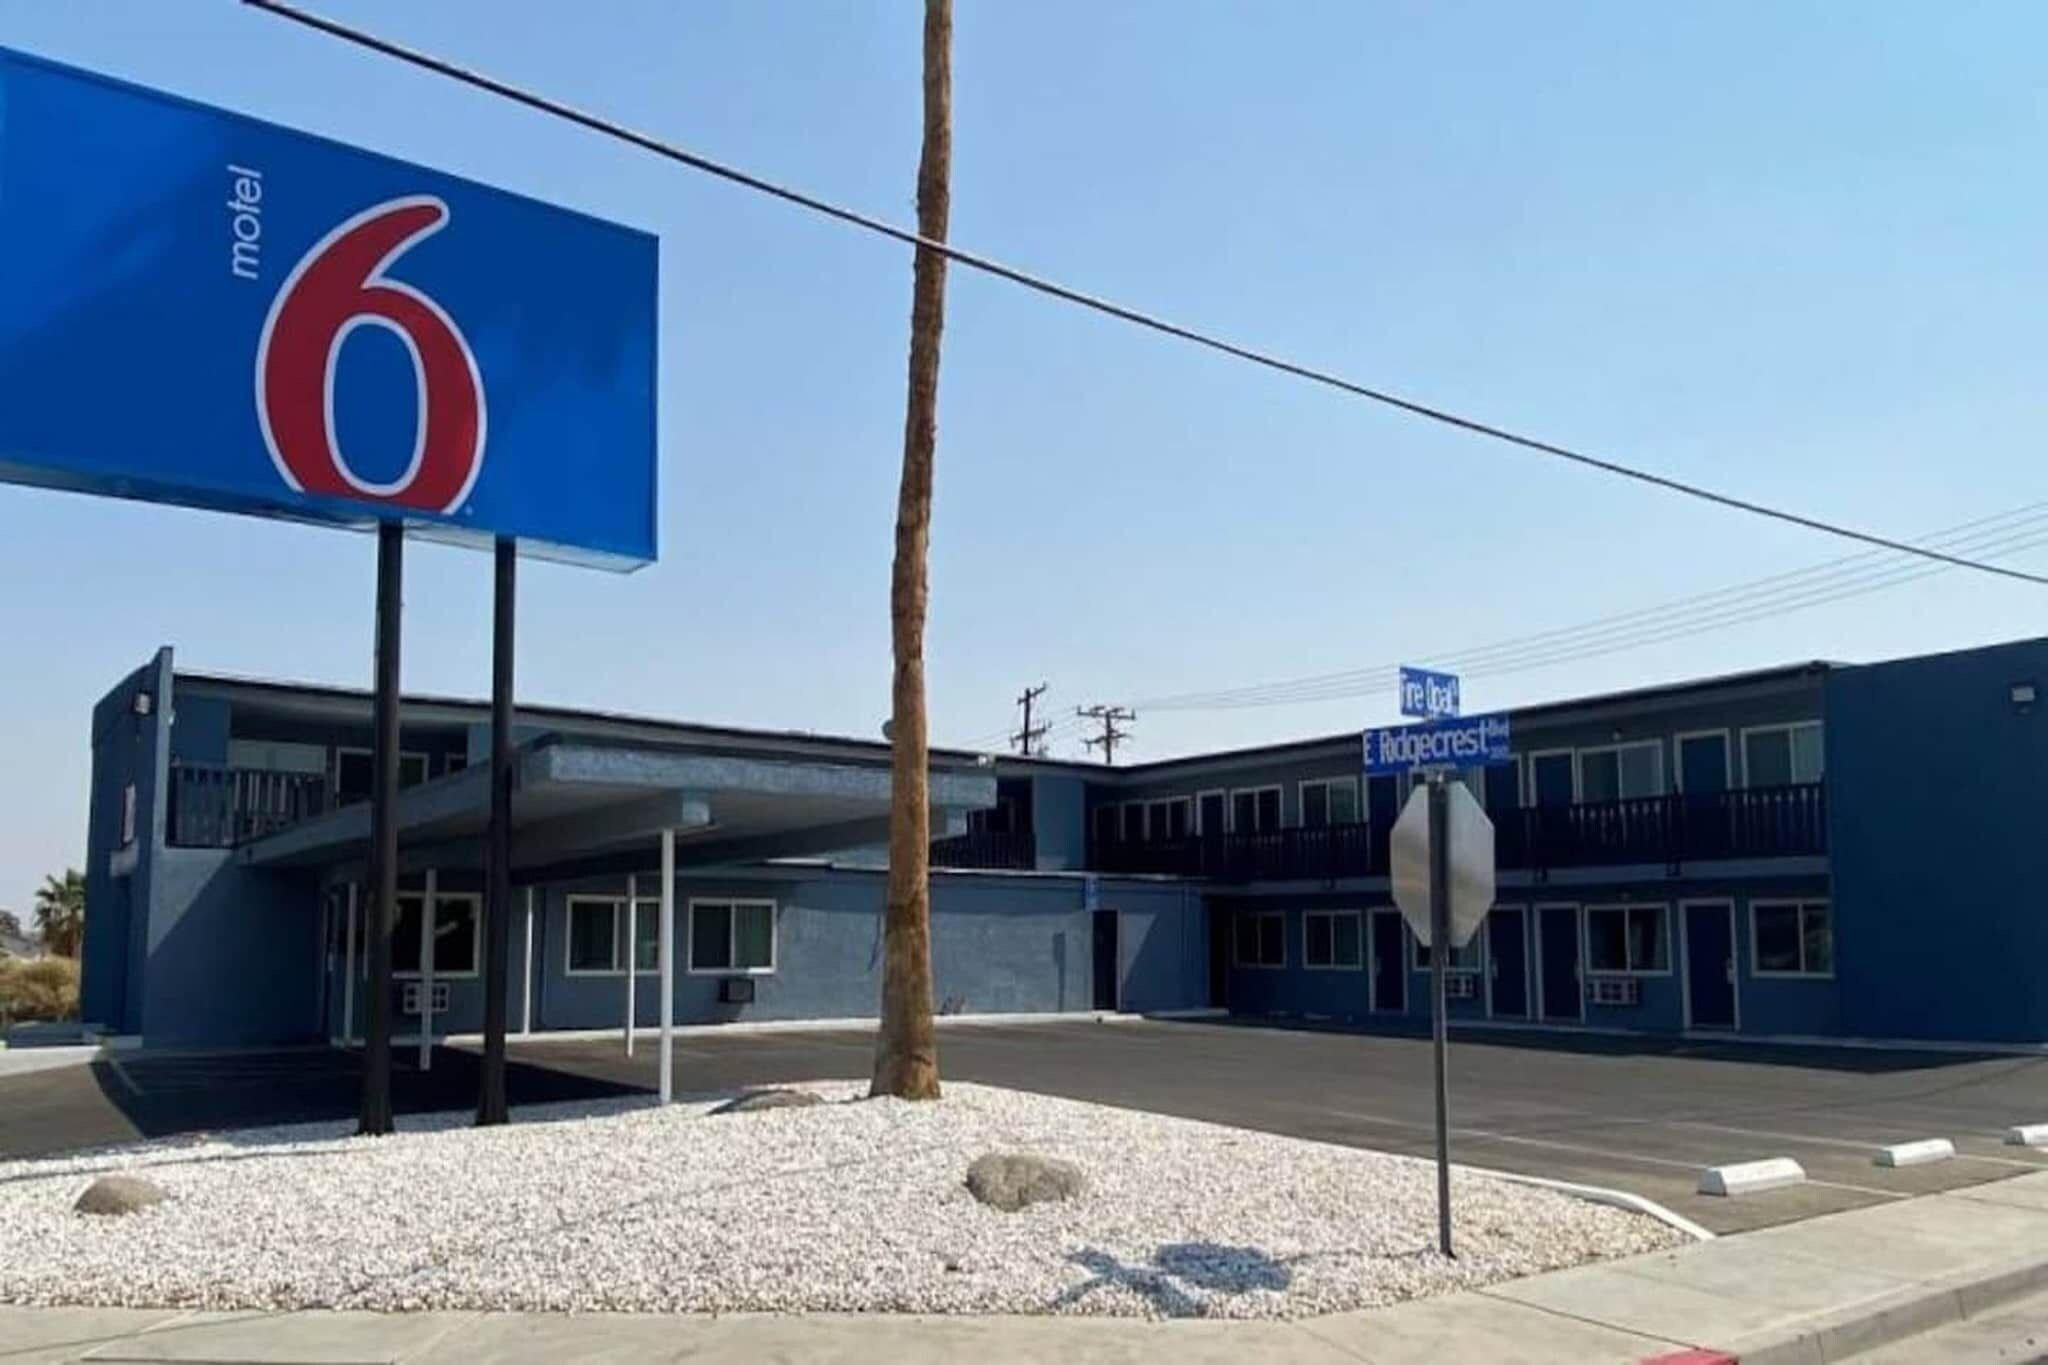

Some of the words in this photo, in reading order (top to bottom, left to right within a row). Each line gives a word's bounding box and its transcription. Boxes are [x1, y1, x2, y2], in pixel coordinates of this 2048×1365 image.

[227, 165, 263, 279] motel
[255, 194, 487, 515] 6
[1363, 731, 1374, 765] E
[1380, 718, 1488, 766] Ridgecrest
